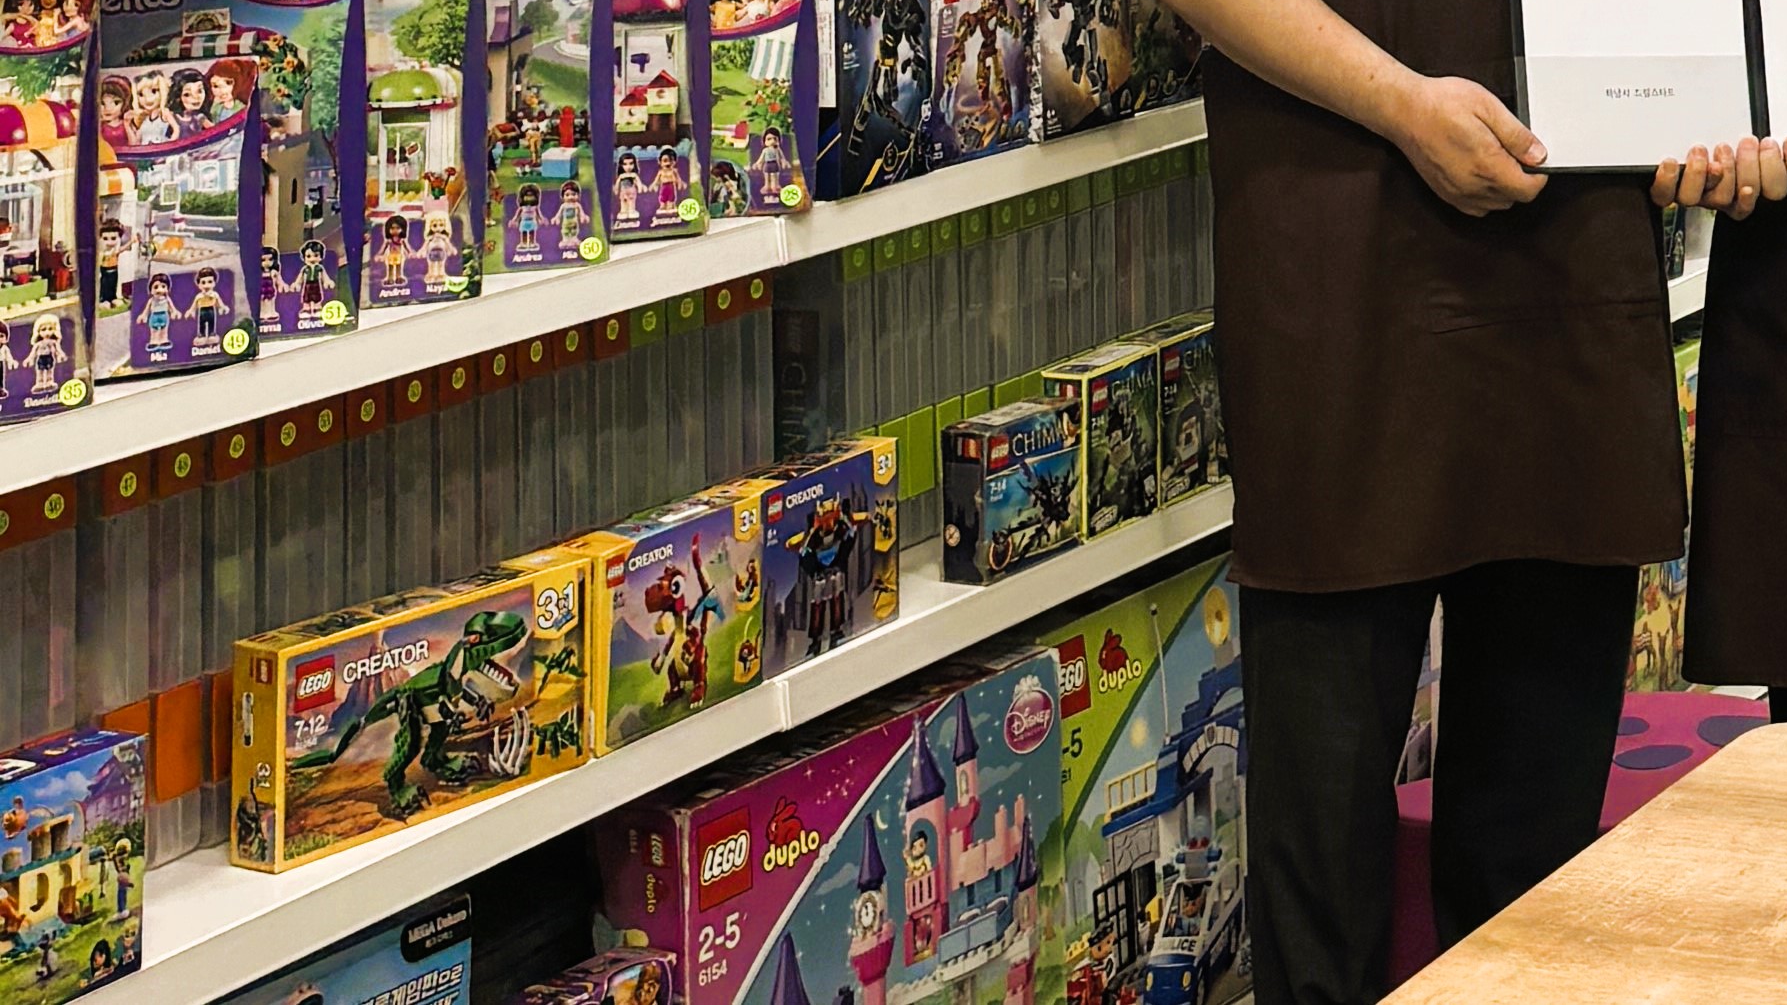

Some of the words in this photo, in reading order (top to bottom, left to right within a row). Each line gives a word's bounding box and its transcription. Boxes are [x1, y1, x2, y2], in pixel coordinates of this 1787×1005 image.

[584, 242, 600, 254] 50
[326, 307, 342, 319] 51
[228, 333, 245, 349] 49
[259, 323, 282, 332] mma
[64, 383, 83, 401] 35
[786, 484, 824, 509] CREATOR
[628, 543, 674, 572] CREATOR
[298, 670, 333, 697] LEGO
[343, 640, 429, 684] CREATOR
[1059, 659, 1084, 693] EGO
[1099, 660, 1142, 693] duplo
[294, 714, 329, 739] 7-12
[1062, 728, 1084, 758] -5
[702, 833, 748, 883] LEGO
[763, 831, 820, 872] duplo
[647, 874, 657, 913] duplo
[699, 912, 740, 963] 2-5
[699, 959, 728, 986] 6154
